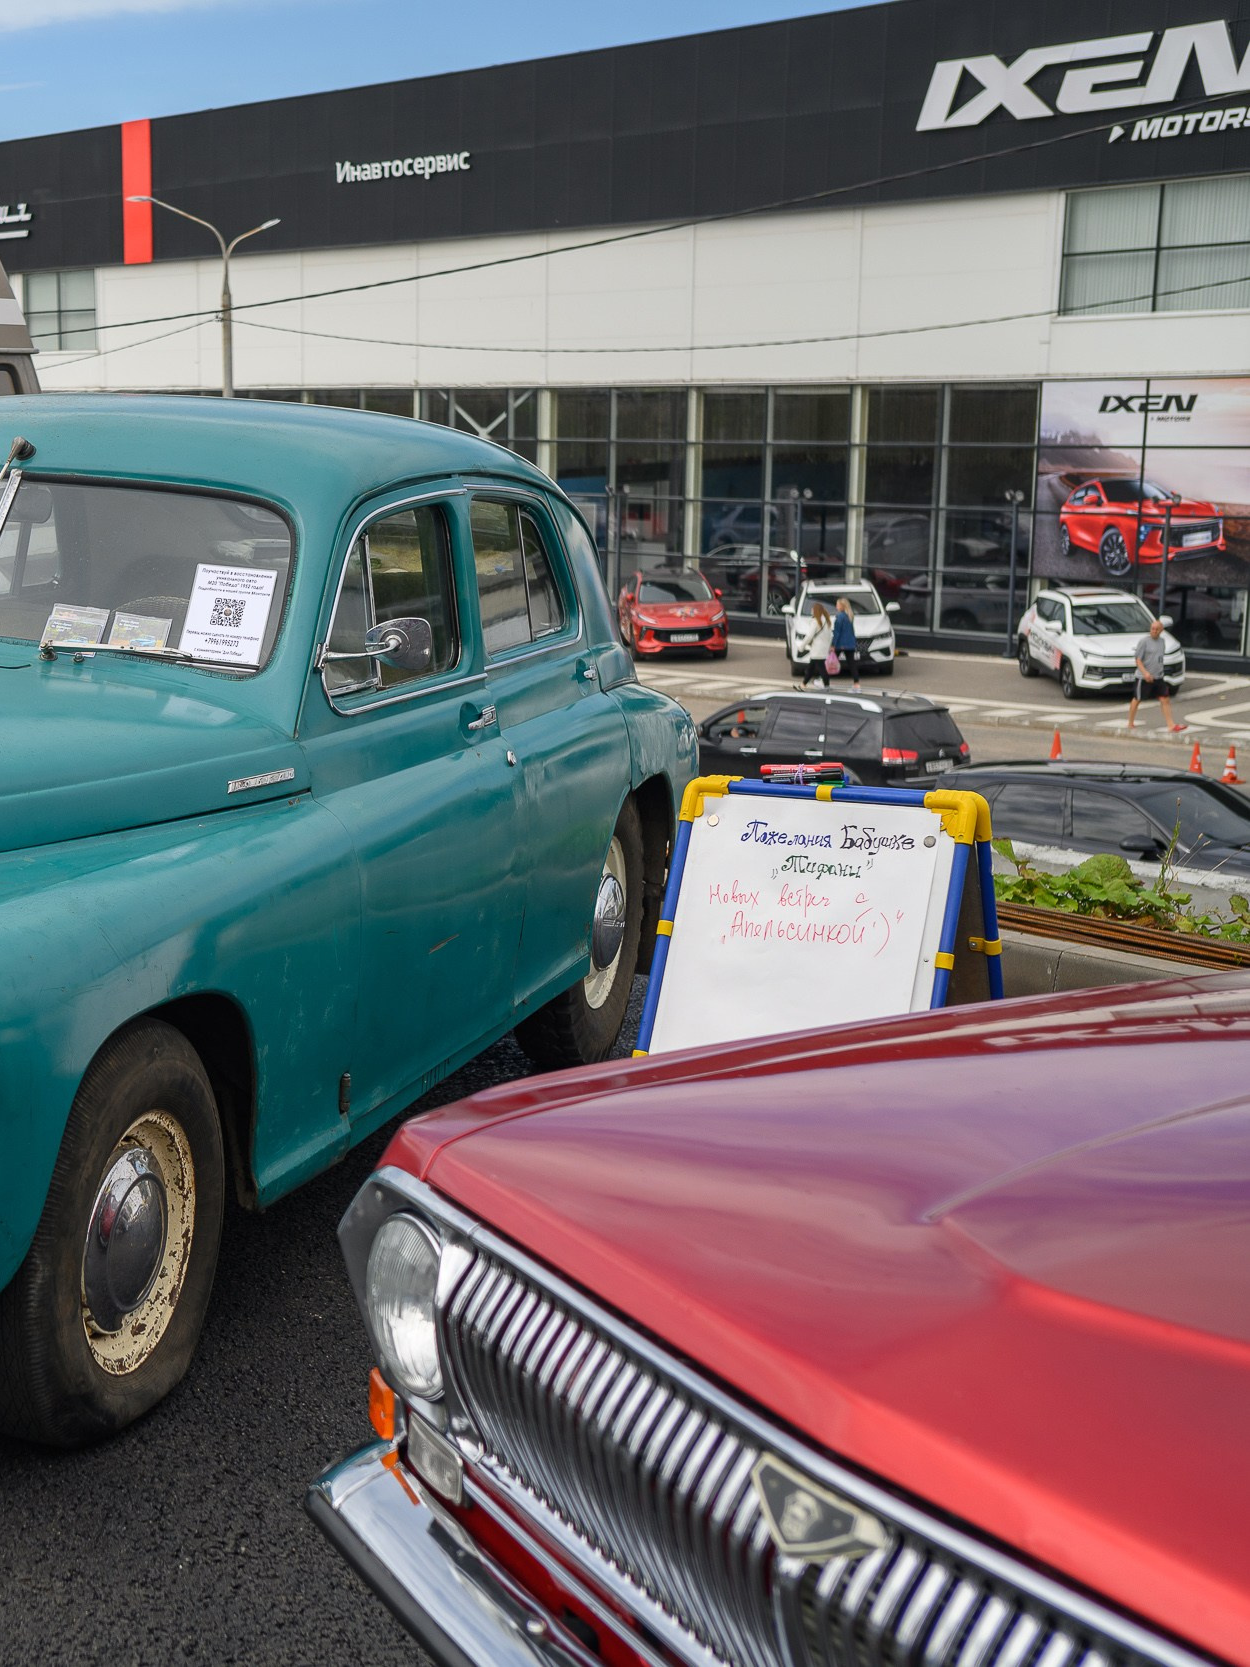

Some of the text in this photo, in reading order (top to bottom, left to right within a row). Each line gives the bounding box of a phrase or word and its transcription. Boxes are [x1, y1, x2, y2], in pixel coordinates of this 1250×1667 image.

[335, 151, 471, 184] Инавтосервис
[1098, 393, 1199, 414] IXEN
[740, 819, 916, 856] Пожелания Бабушке
[709, 879, 760, 910] Новых
